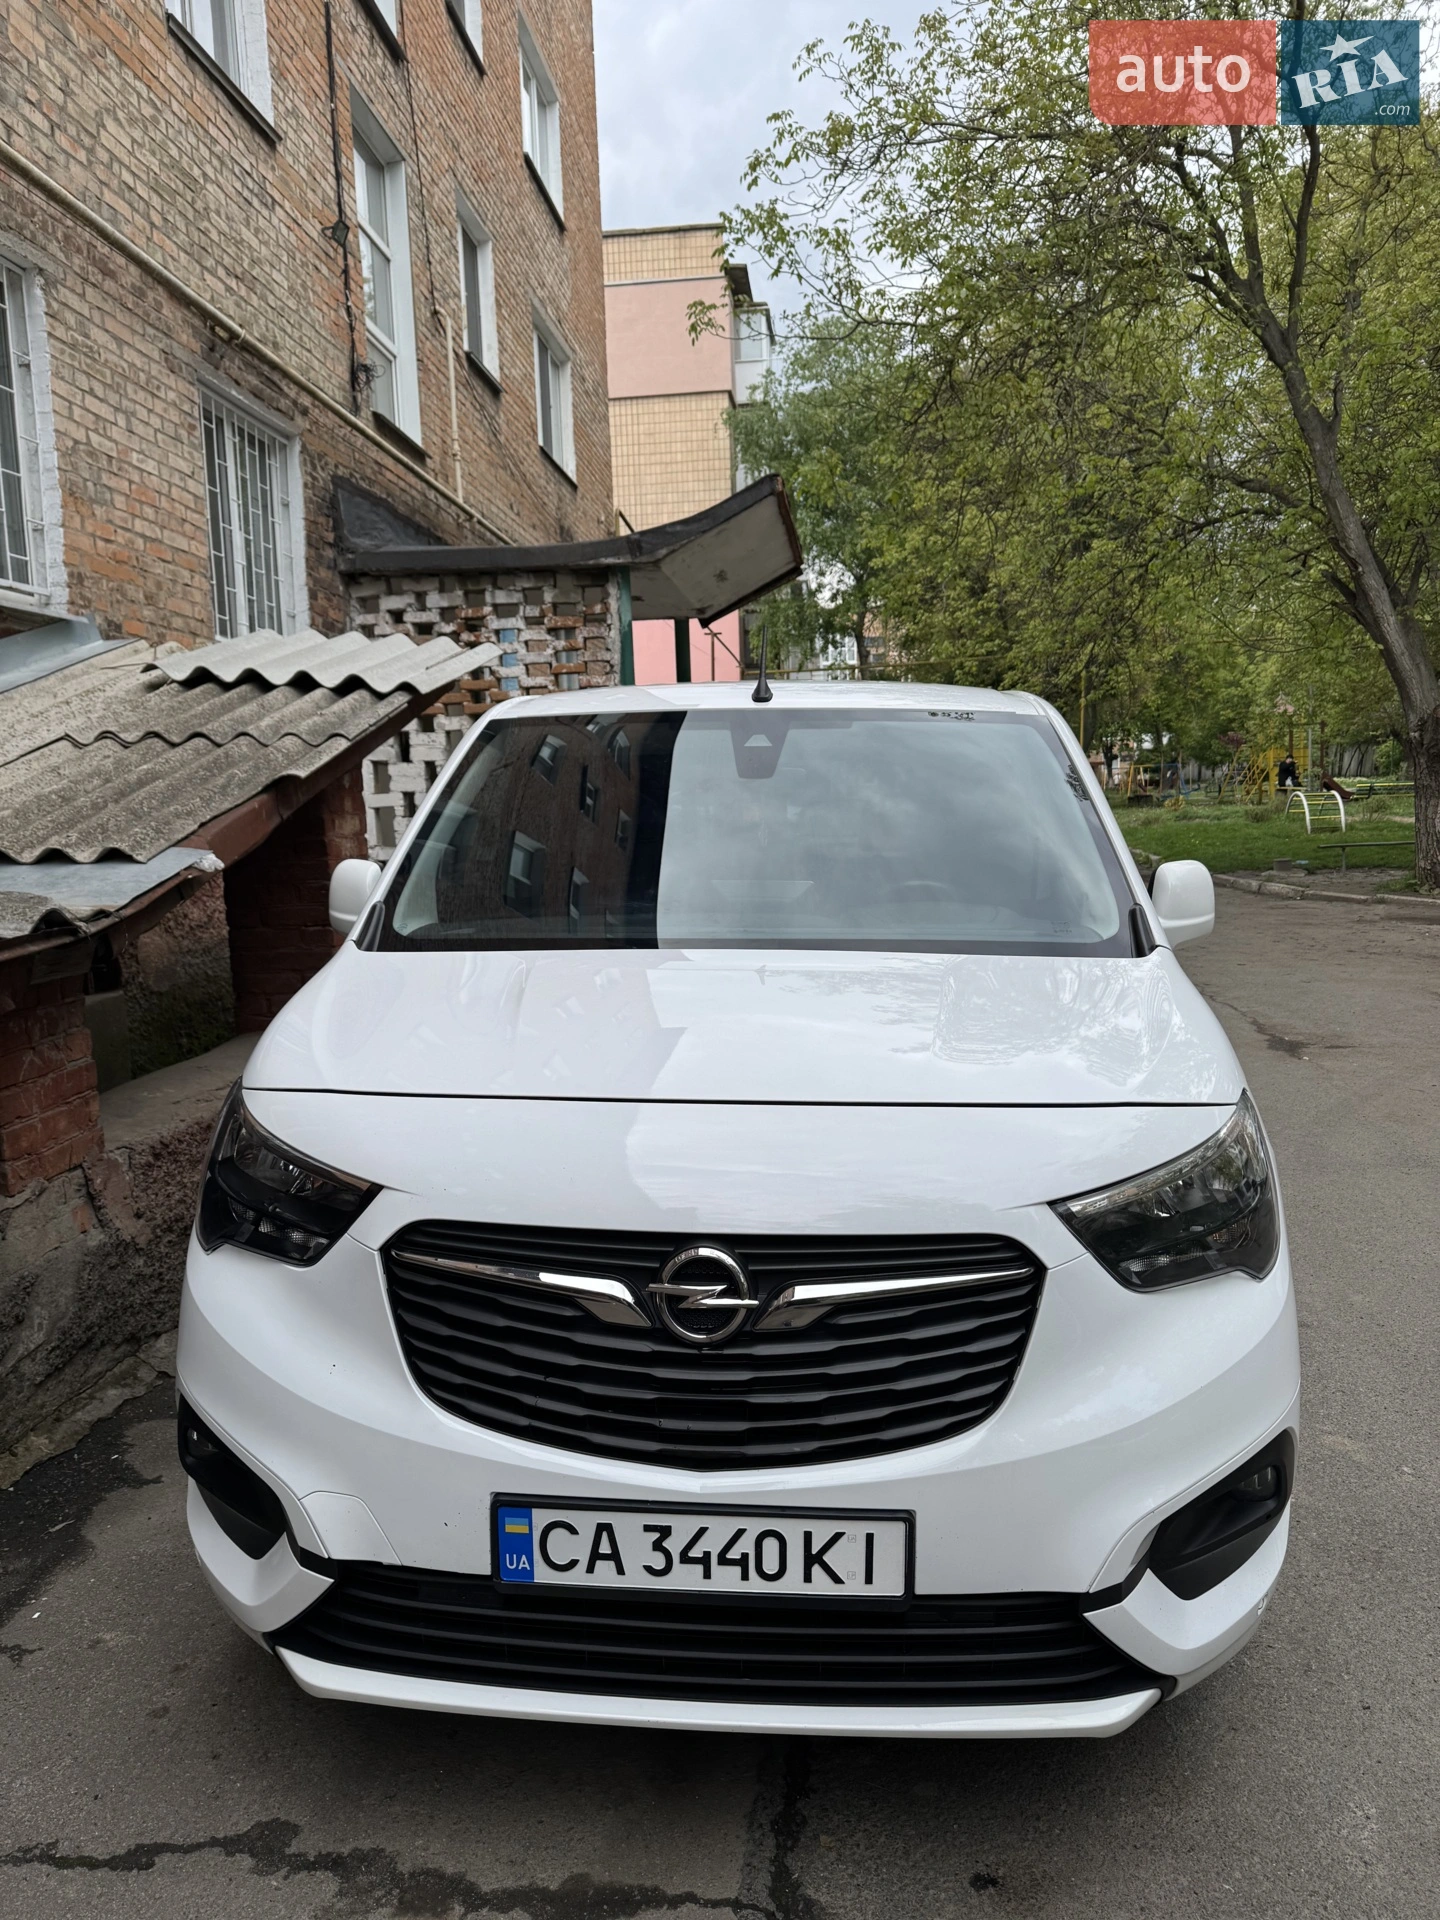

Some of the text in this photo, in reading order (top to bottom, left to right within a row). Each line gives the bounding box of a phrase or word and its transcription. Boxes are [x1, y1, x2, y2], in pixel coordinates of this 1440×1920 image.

[506, 1554, 531, 1571] UA
[539, 1519, 875, 1585] CA 3440 KI
